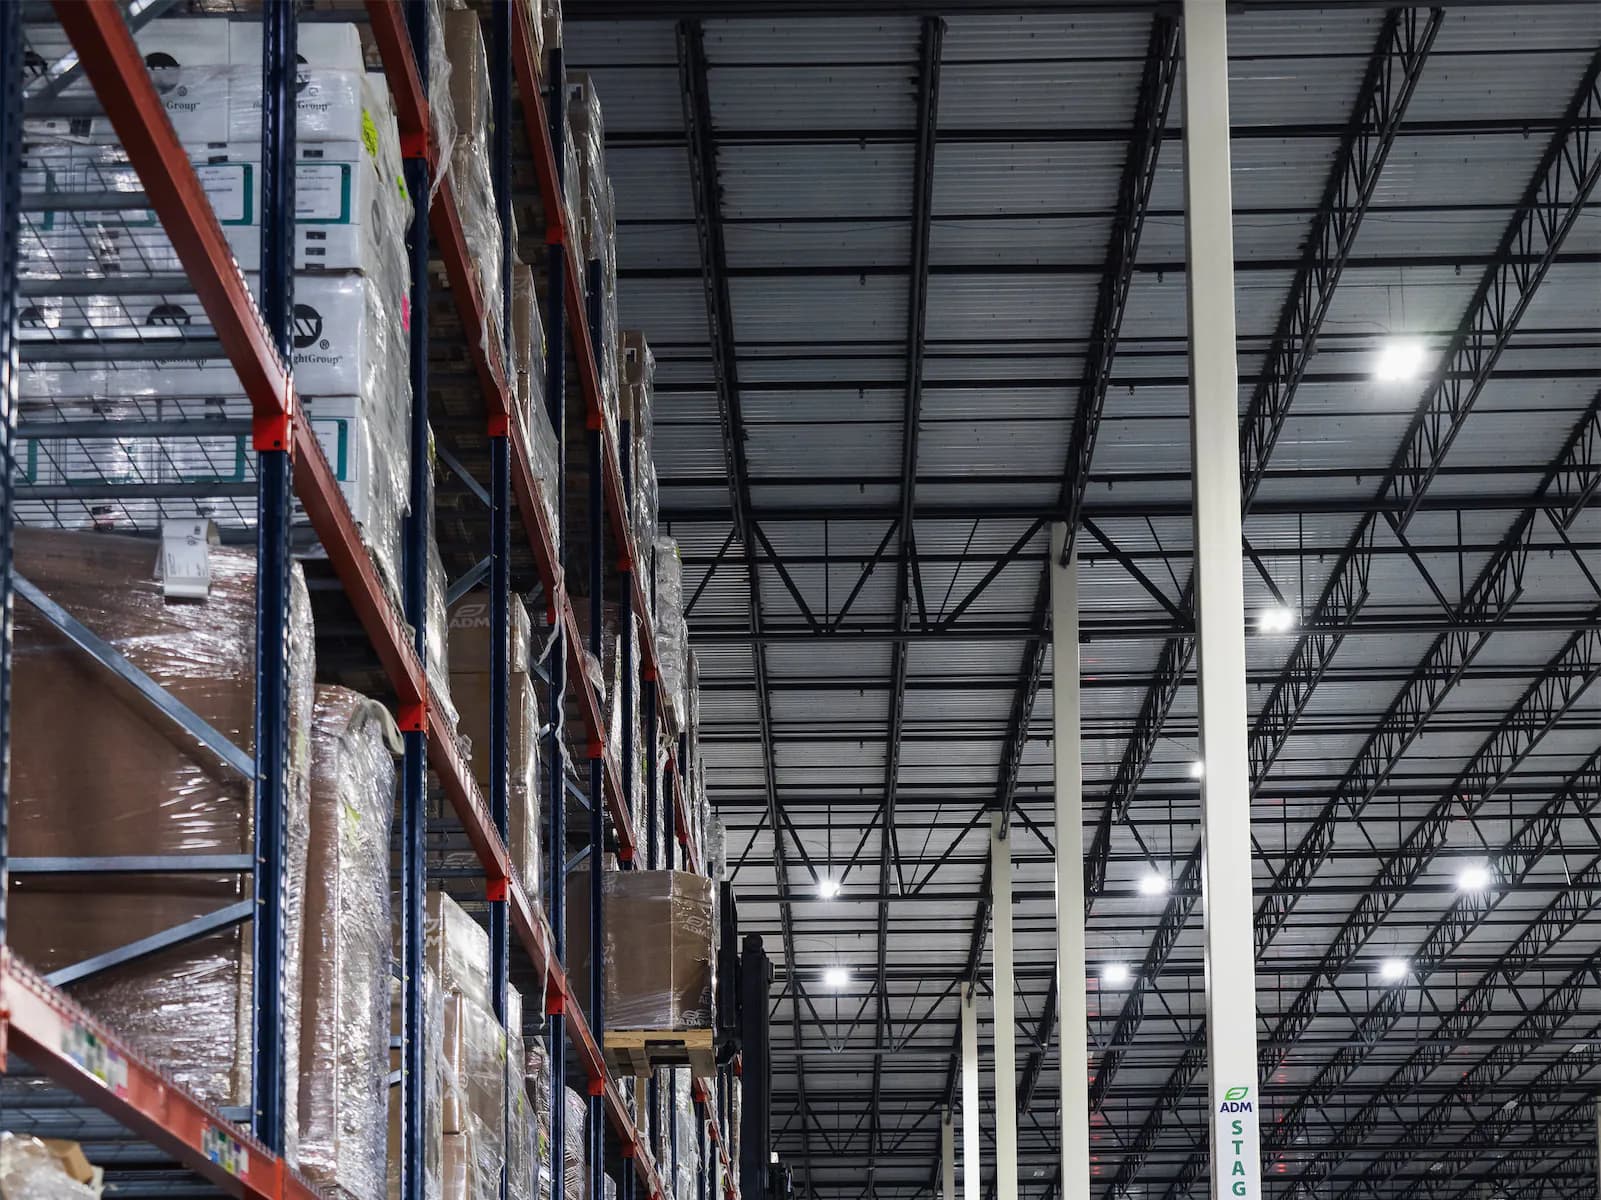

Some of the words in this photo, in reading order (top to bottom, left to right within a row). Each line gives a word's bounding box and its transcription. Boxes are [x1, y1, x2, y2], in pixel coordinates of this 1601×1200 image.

[166, 101, 196, 112] Group
[297, 101, 328, 112] Group
[294, 353, 339, 366] ghtGroup
[449, 616, 491, 629] ADM
[681, 924, 707, 938] ADM
[1219, 1102, 1253, 1113] ADM
